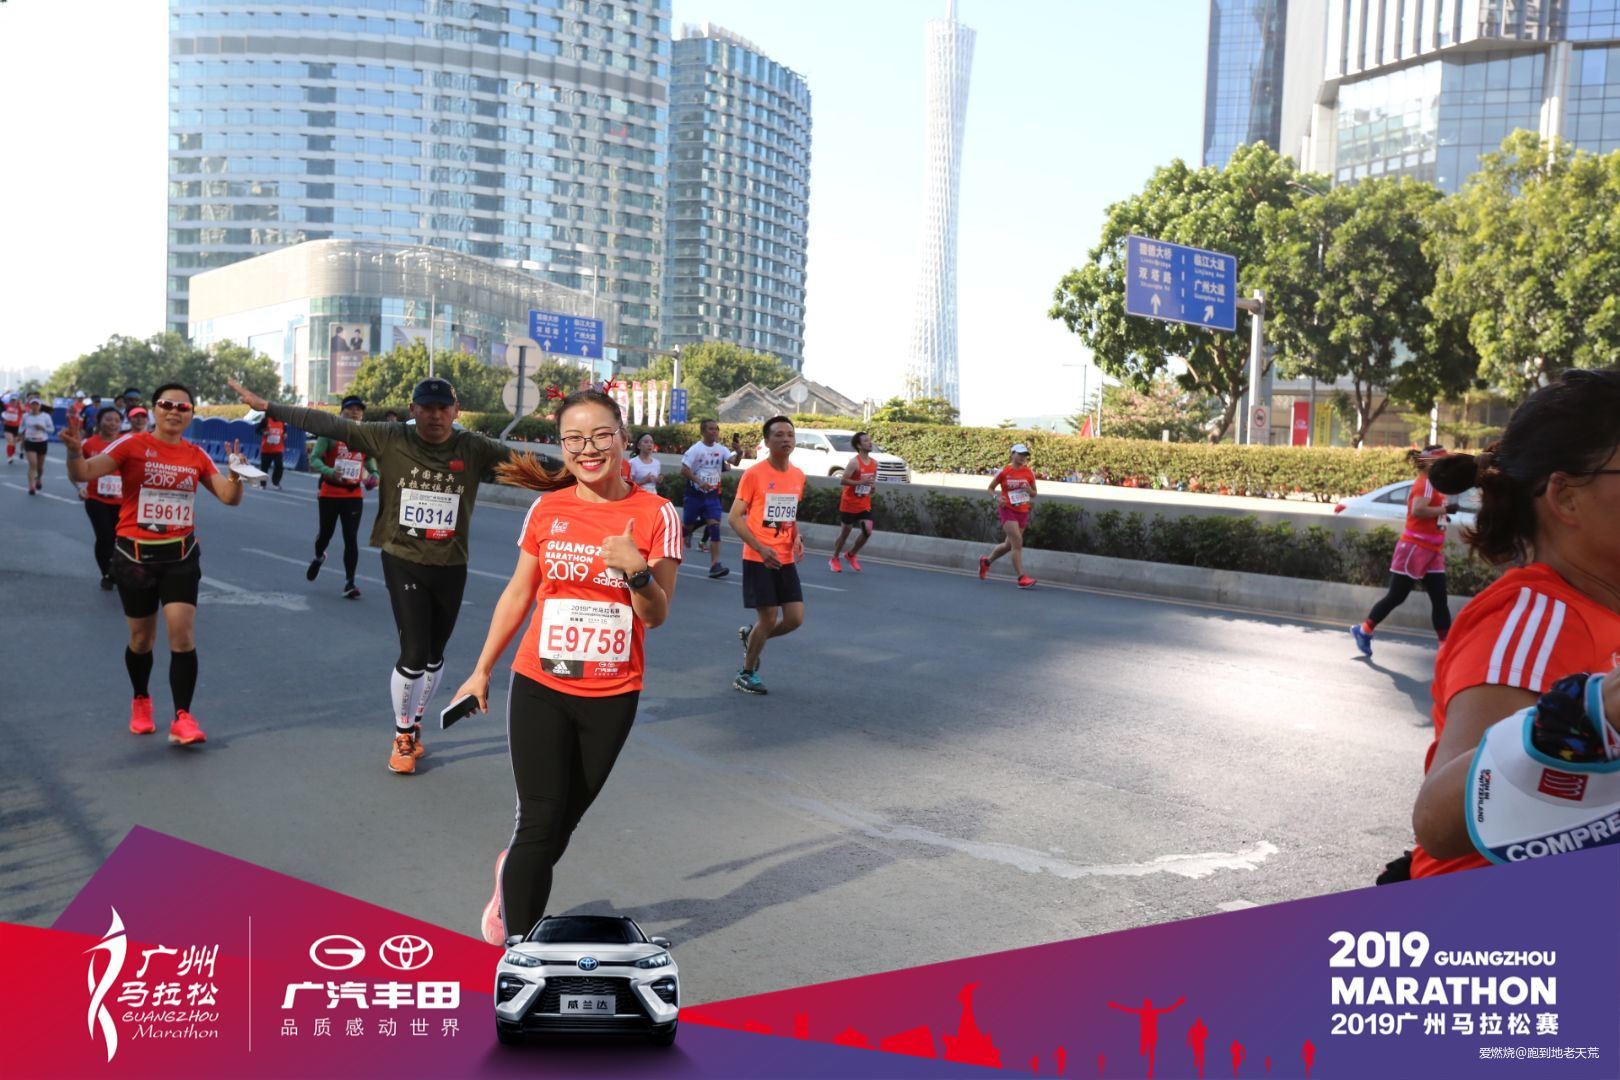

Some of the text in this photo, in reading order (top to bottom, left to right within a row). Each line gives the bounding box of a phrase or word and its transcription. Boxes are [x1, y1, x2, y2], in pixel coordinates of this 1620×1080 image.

[145, 461, 197, 475] GUANGZHOU
[143, 472, 176, 488] 2019
[143, 503, 190, 521] E9612
[404, 505, 453, 526] E0314
[767, 505, 796, 518] E0796
[547, 540, 602, 557] GUANGZ
[545, 551, 594, 564] MARATHON
[545, 559, 589, 582] 2019
[547, 624, 626, 655] E9758
